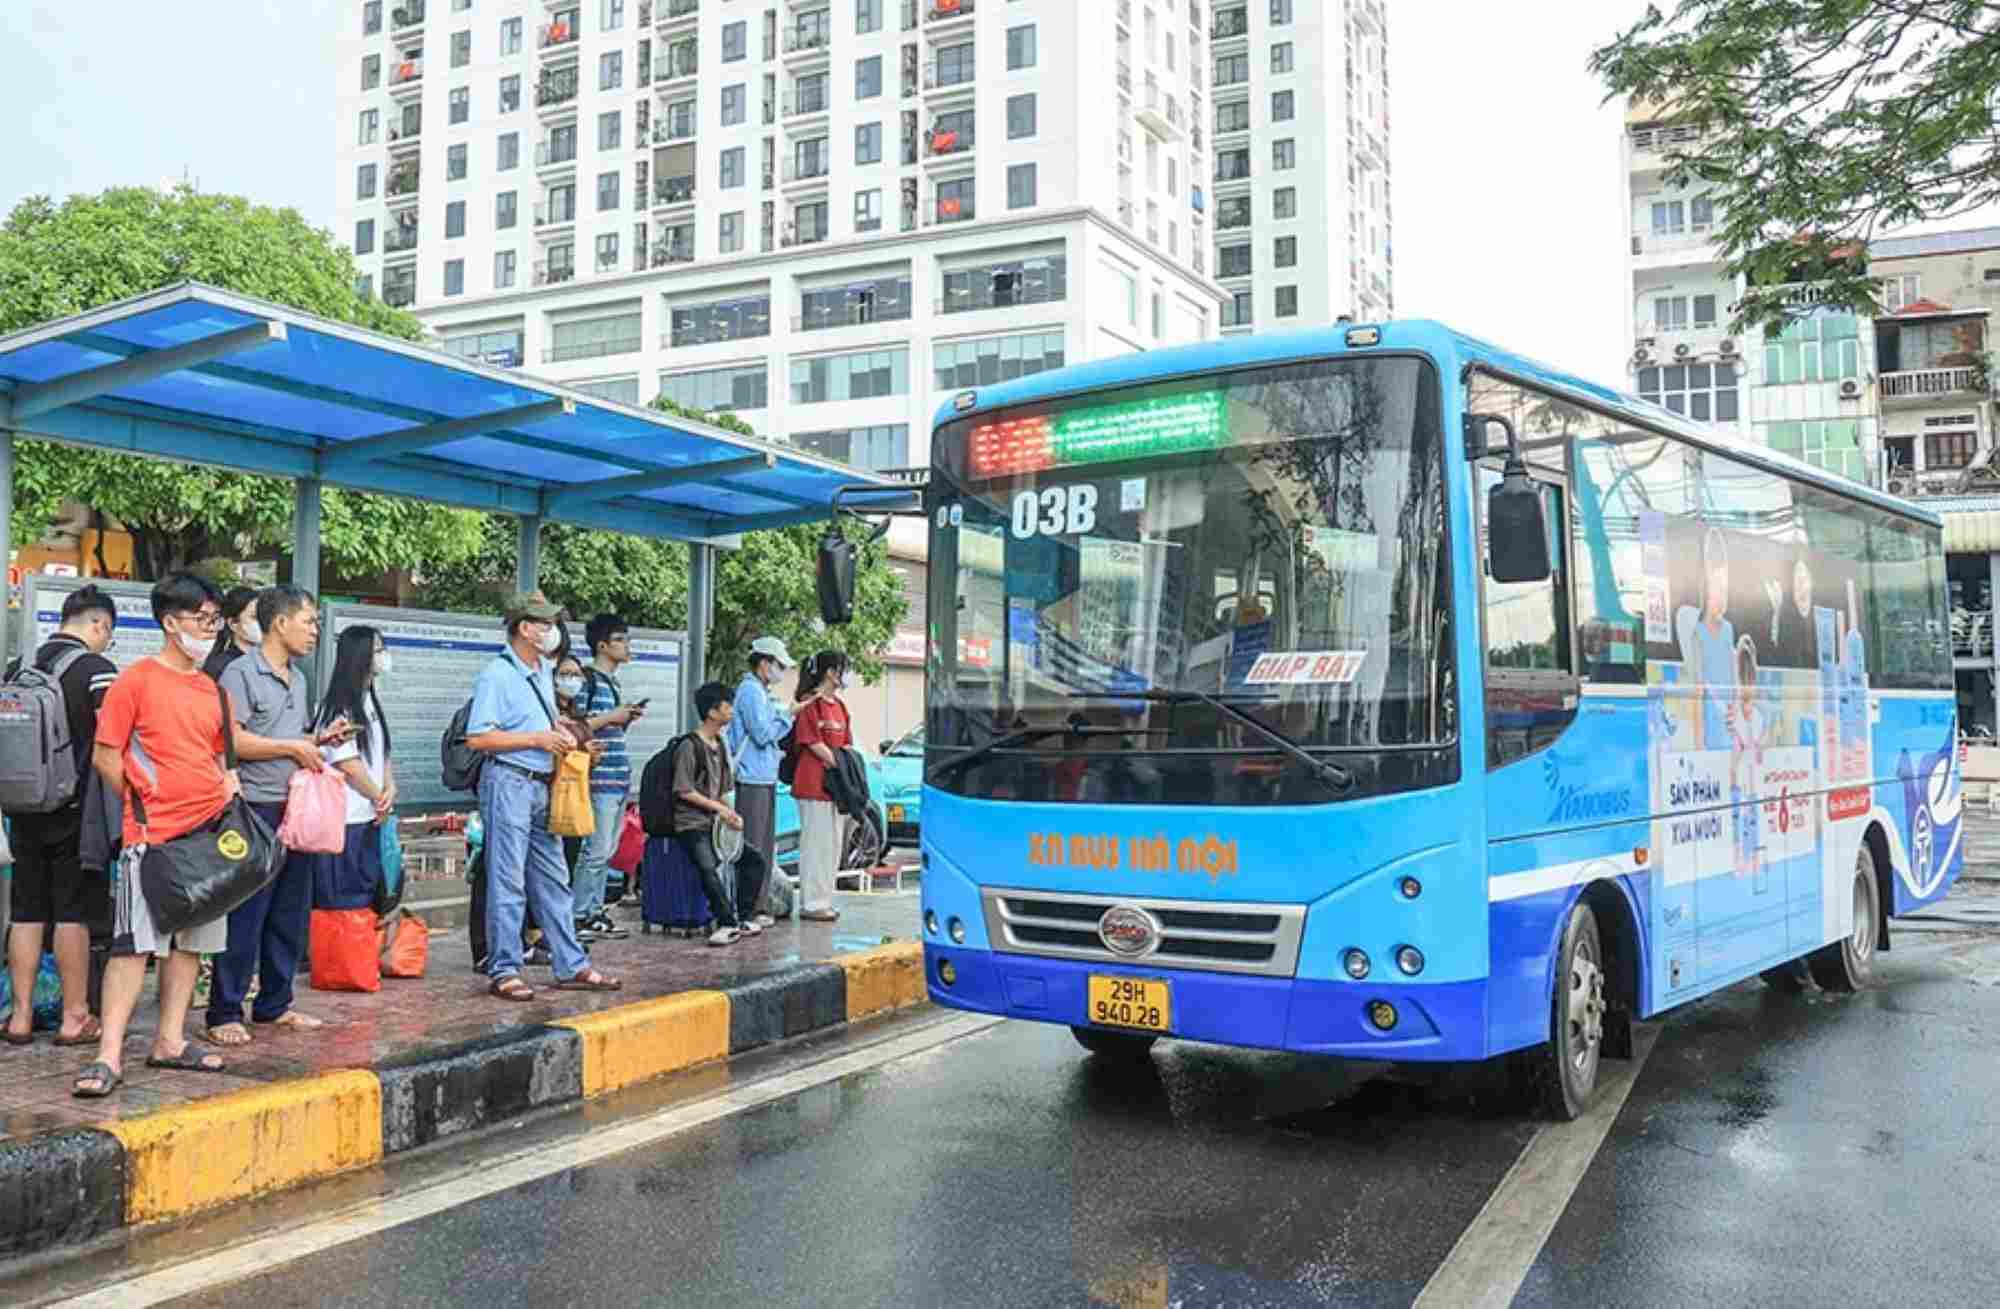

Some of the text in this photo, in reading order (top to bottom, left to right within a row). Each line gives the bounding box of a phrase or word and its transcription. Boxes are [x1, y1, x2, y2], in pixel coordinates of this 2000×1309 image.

[1011, 484, 1099, 539] 03B
[1111, 980, 1145, 1002] 29H
[1096, 1001, 1160, 1026] 940.28
